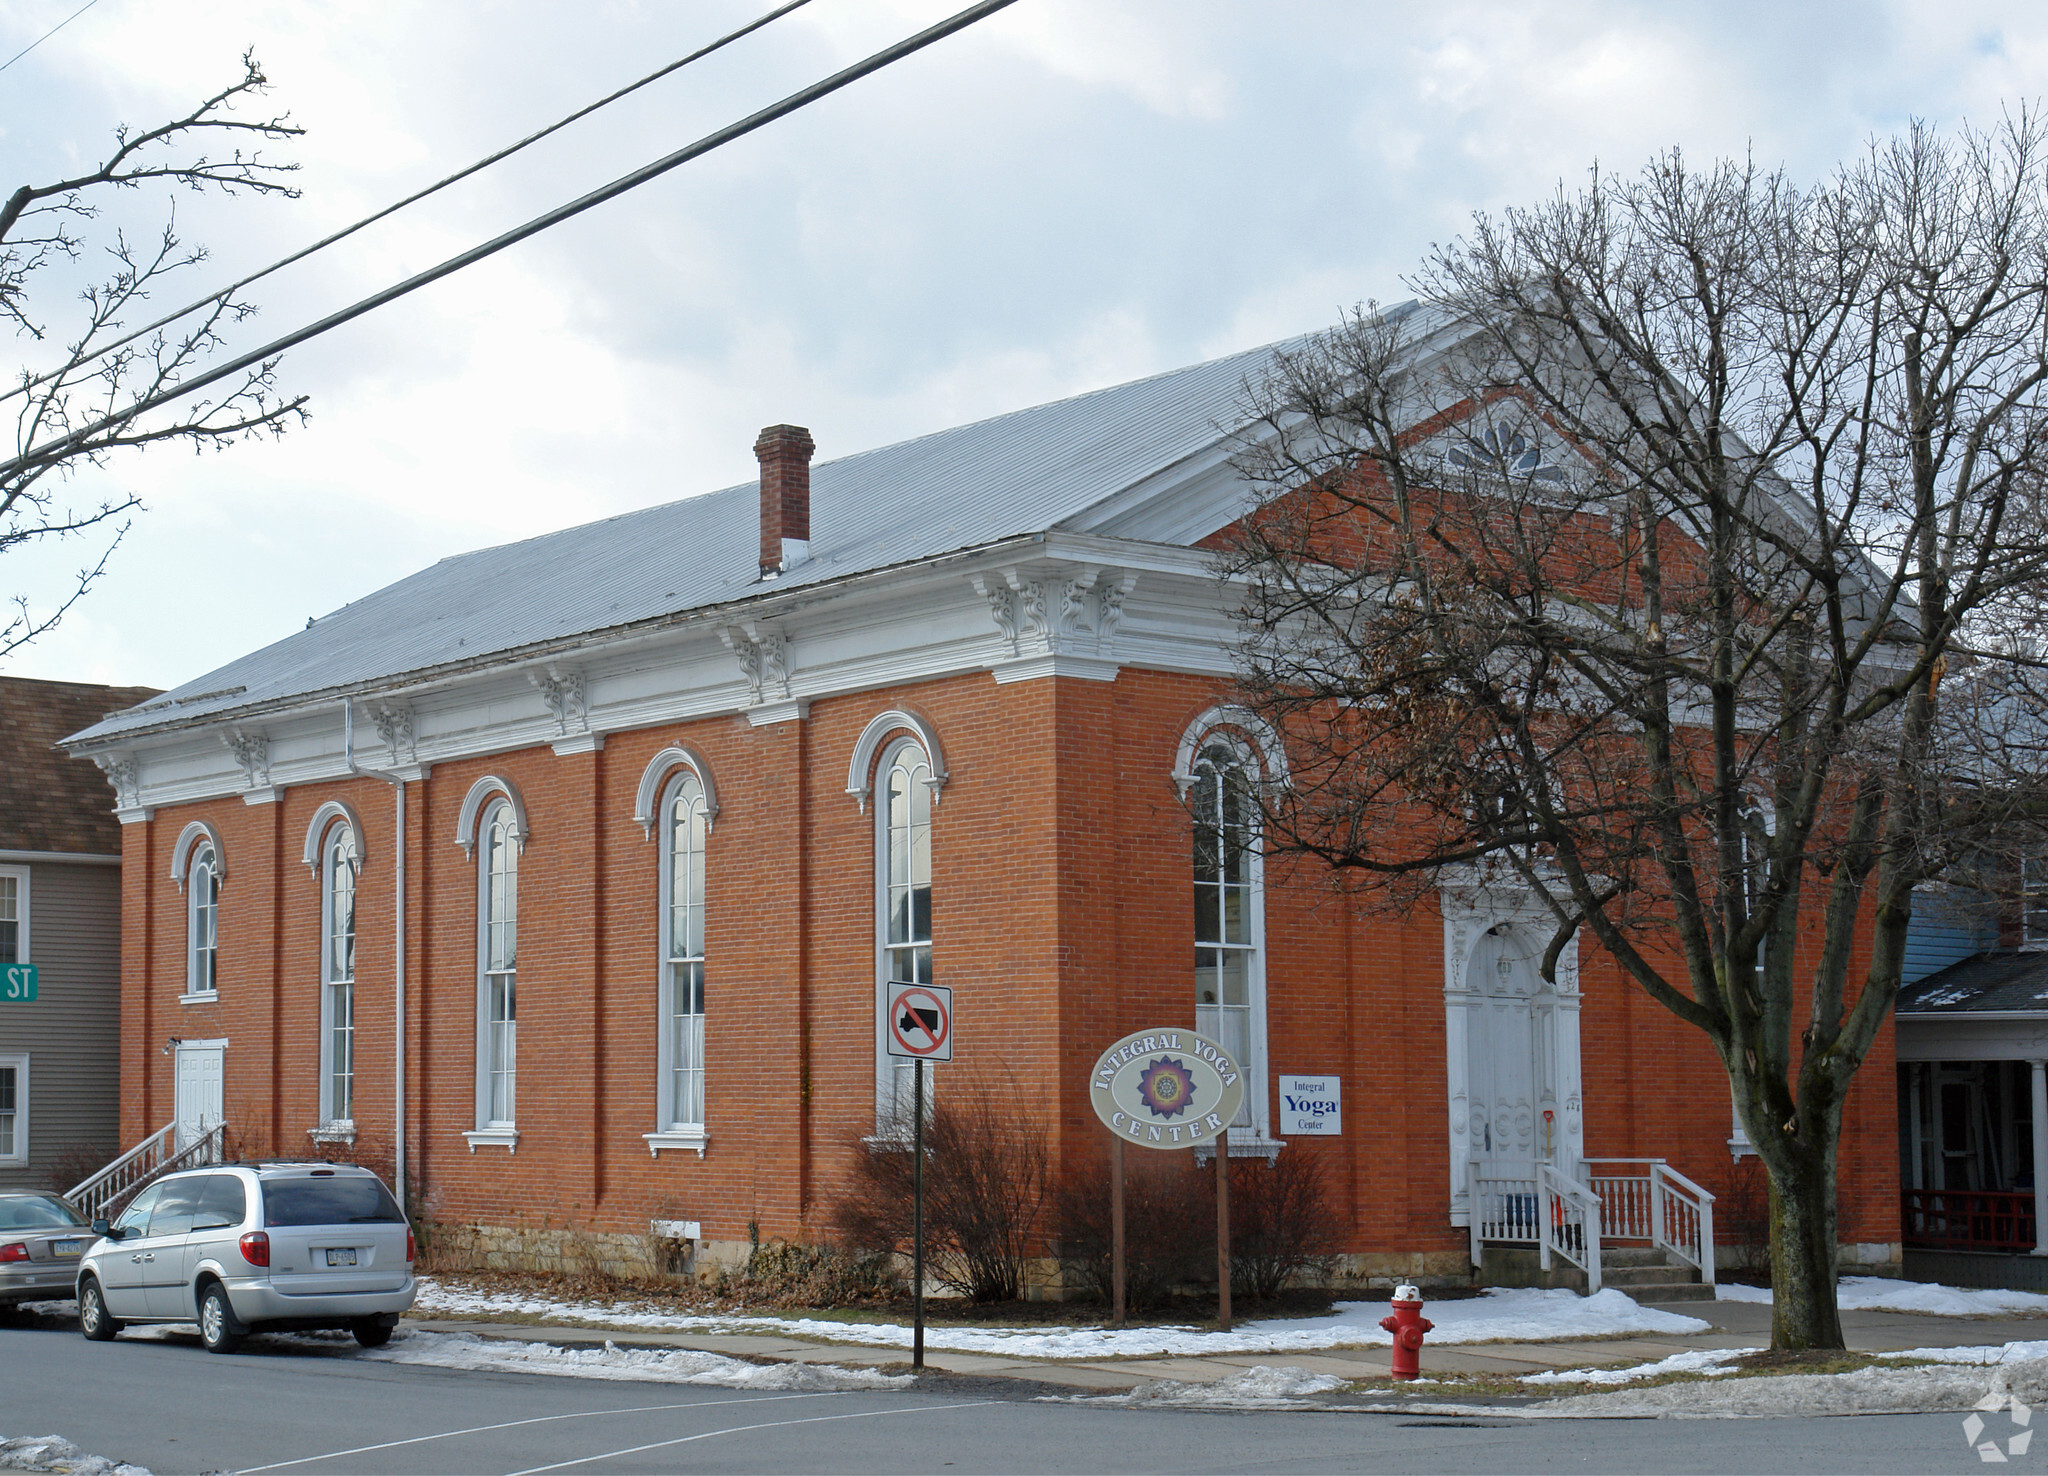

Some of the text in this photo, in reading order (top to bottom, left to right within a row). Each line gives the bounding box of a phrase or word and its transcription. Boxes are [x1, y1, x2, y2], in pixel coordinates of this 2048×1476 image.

[7, 967, 32, 998] ST
[1095, 1034, 1237, 1090] INTEGRAL YOGA
[1294, 1081, 1325, 1094] Integral
[1284, 1095, 1337, 1117] Yoga
[1112, 1112, 1222, 1141] CENTER
[1298, 1119, 1323, 1130] Center
